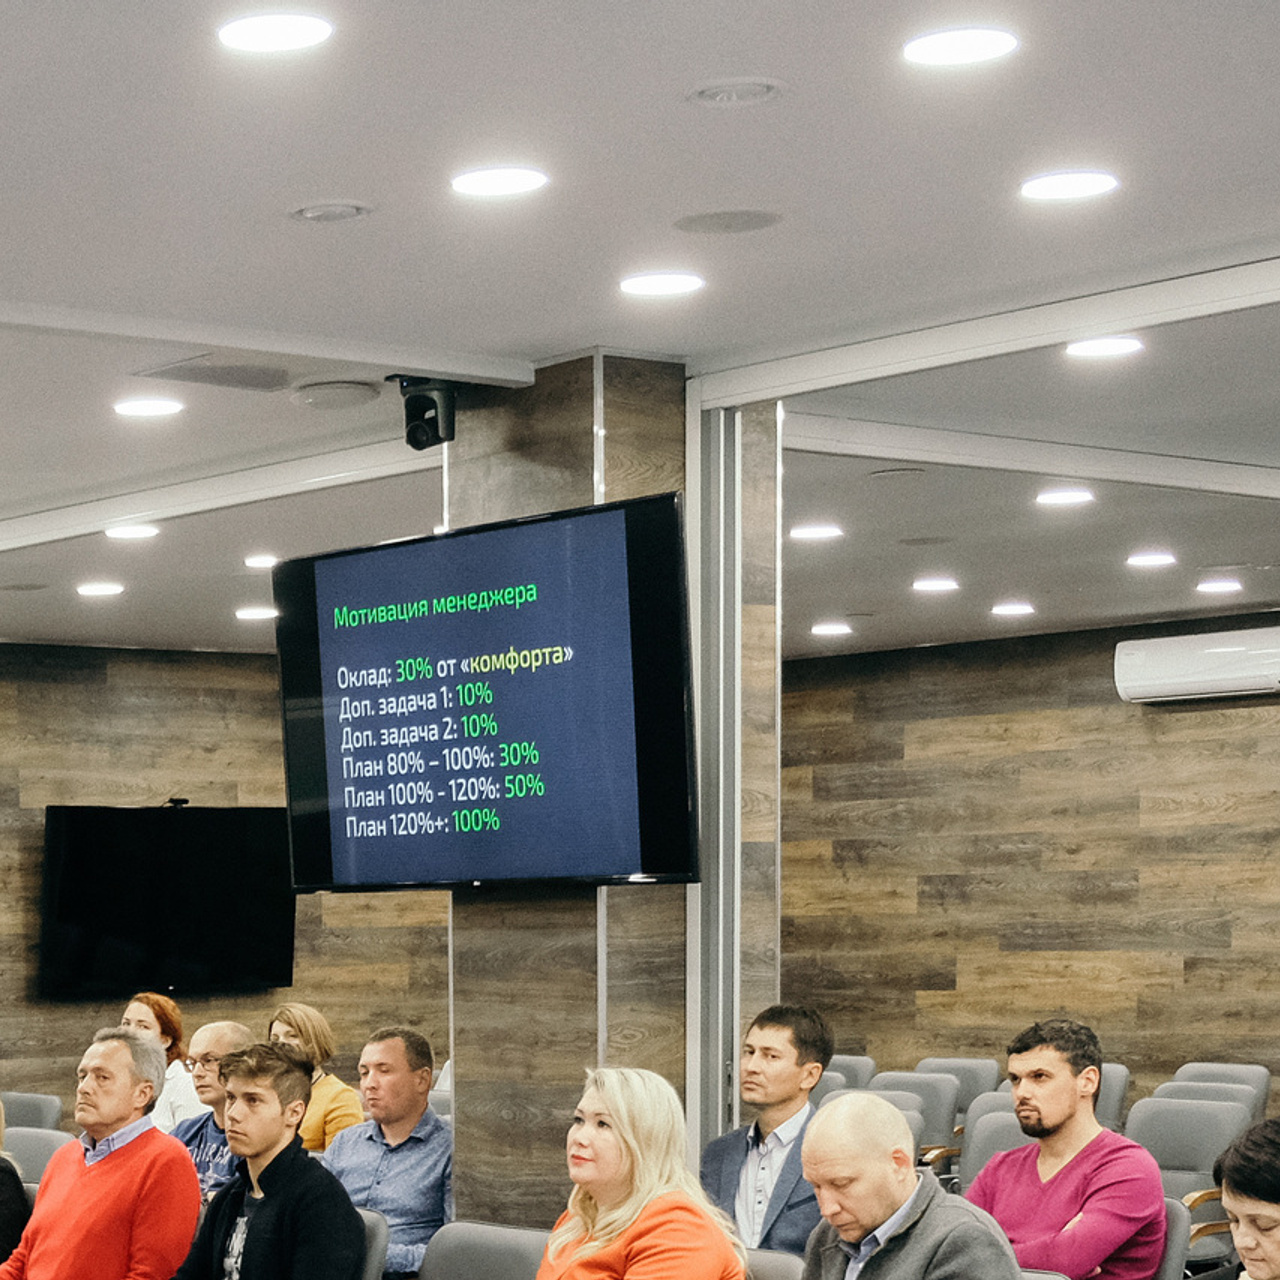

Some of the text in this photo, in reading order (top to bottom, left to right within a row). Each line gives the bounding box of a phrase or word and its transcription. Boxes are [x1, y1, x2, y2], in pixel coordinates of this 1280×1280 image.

[334, 583, 537, 629] Мотивация менеджера
[337, 646, 574, 689] Оклад: 30% от «комфорта»
[339, 681, 493, 723] Доп. задача 1: 10%
[341, 713, 498, 752] Доп. задача 2: 10%
[342, 757, 383, 779] План
[387, 751, 425, 776] 80%
[442, 745, 495, 771] 100%:
[499, 741, 540, 767] 30%
[344, 787, 385, 808] План
[388, 781, 434, 805] 100%
[448, 776, 500, 801] 120%:
[505, 773, 545, 798] 50%
[346, 808, 500, 838] План 120%+: 100%
